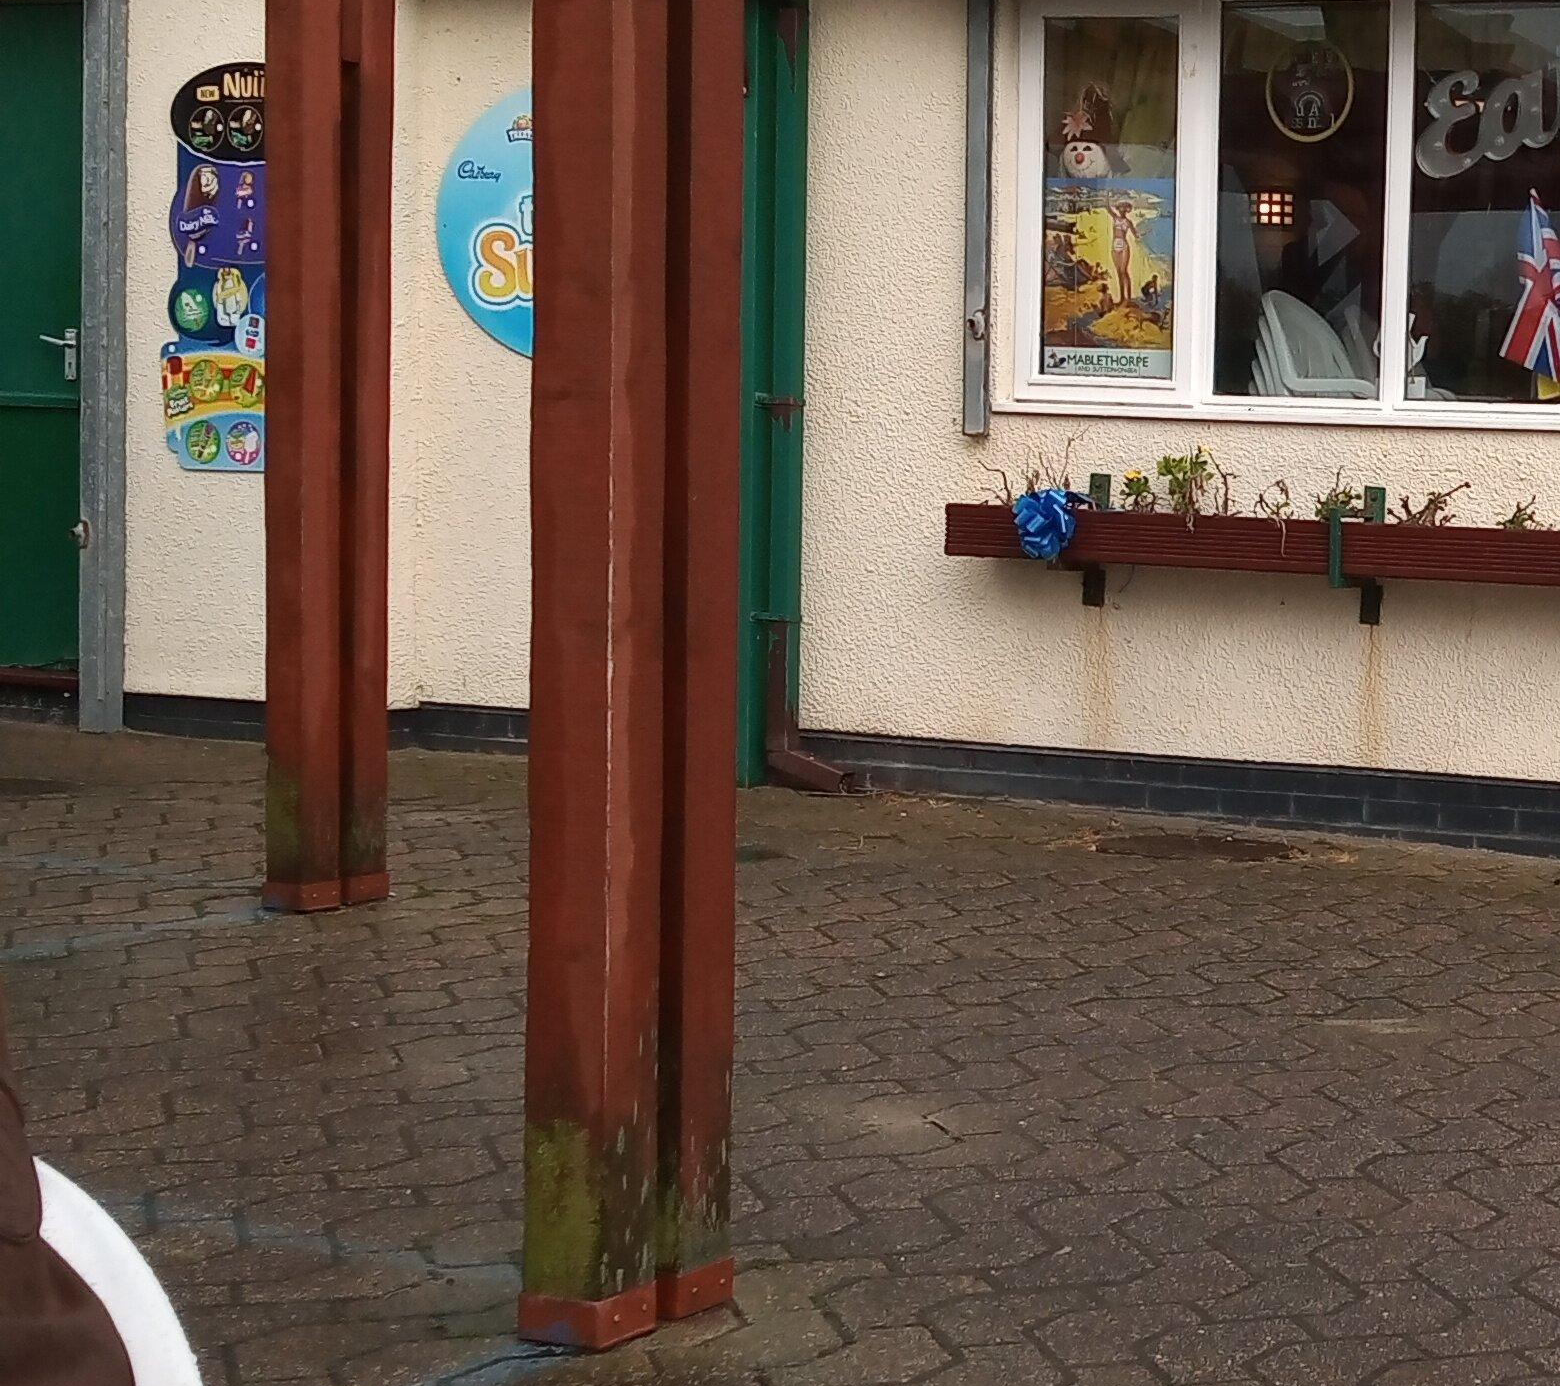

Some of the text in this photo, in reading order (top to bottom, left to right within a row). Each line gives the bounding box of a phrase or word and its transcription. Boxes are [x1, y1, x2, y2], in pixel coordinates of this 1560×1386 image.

[200, 89, 216, 98] NEW
[179, 217, 200, 232] Dairy
[1067, 354, 1149, 367] MABLETHORPE
